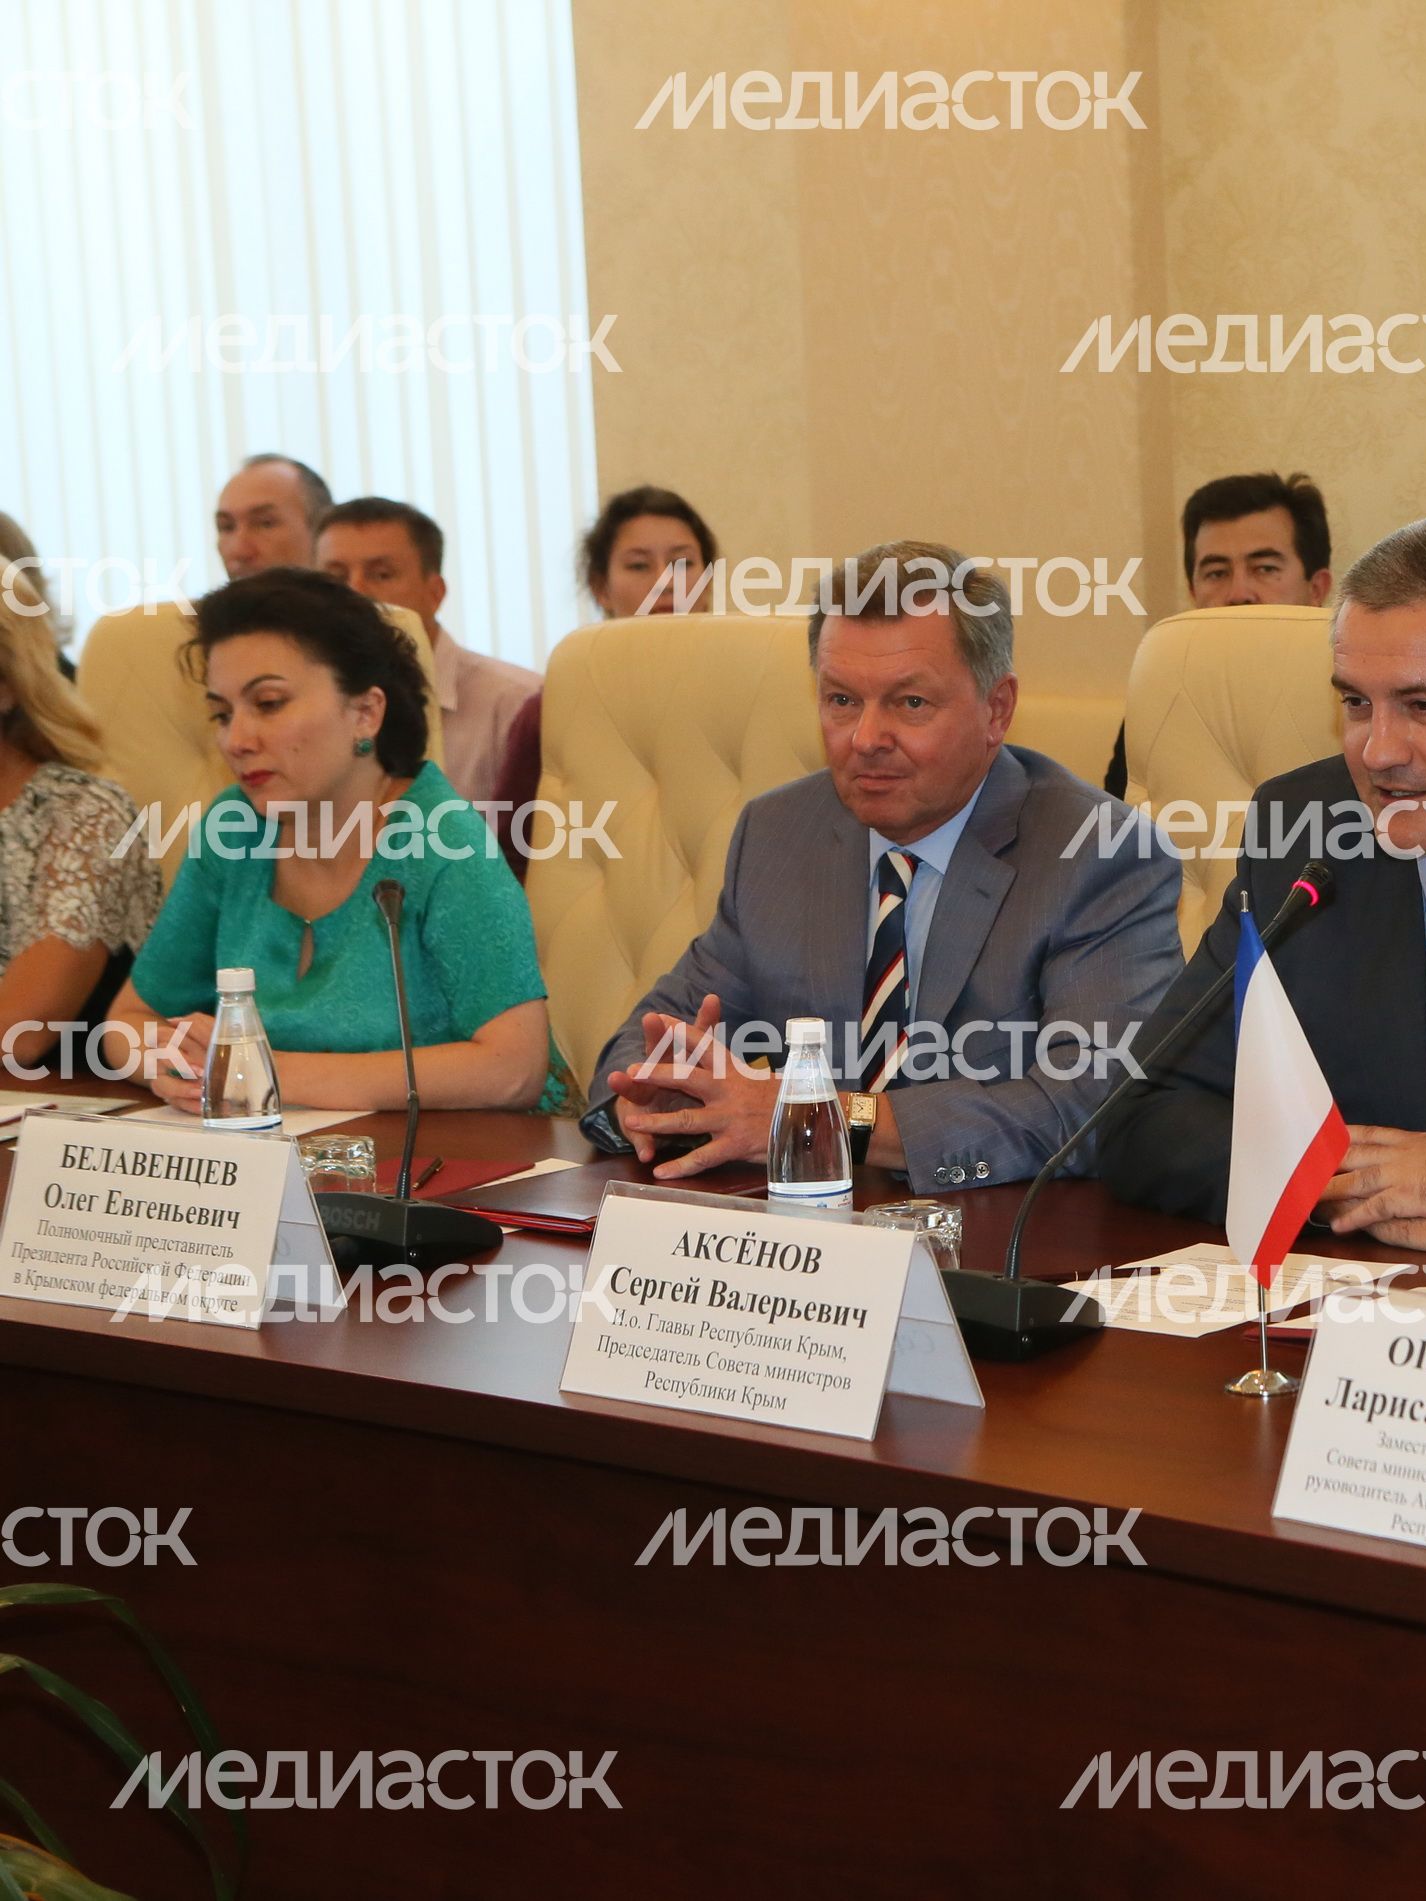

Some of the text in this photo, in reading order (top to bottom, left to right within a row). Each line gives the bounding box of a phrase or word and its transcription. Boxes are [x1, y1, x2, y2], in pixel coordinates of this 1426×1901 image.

[61, 1144, 238, 1189] БЕЛАВЕНЦЕВ
[44, 1182, 241, 1229] Олег Евгеньевич
[320, 1203, 381, 1231] BOSCH
[37, 1219, 234, 1259] Полномочный представитель
[671, 1230, 822, 1275] АКСЁНОВ
[11, 1242, 250, 1287] Президента Российской Федерации
[13, 1269, 238, 1314] в Крымском федеральном округе
[610, 1266, 868, 1329] Сергей Валерьевич
[612, 1308, 847, 1363] И.о. Главы Республики Крым,
[598, 1334, 851, 1391] Председатель Совета министров
[644, 1370, 787, 1410] Республики Крым
[1325, 1448, 1378, 1473] Совета
[1305, 1473, 1408, 1505] руководитель
